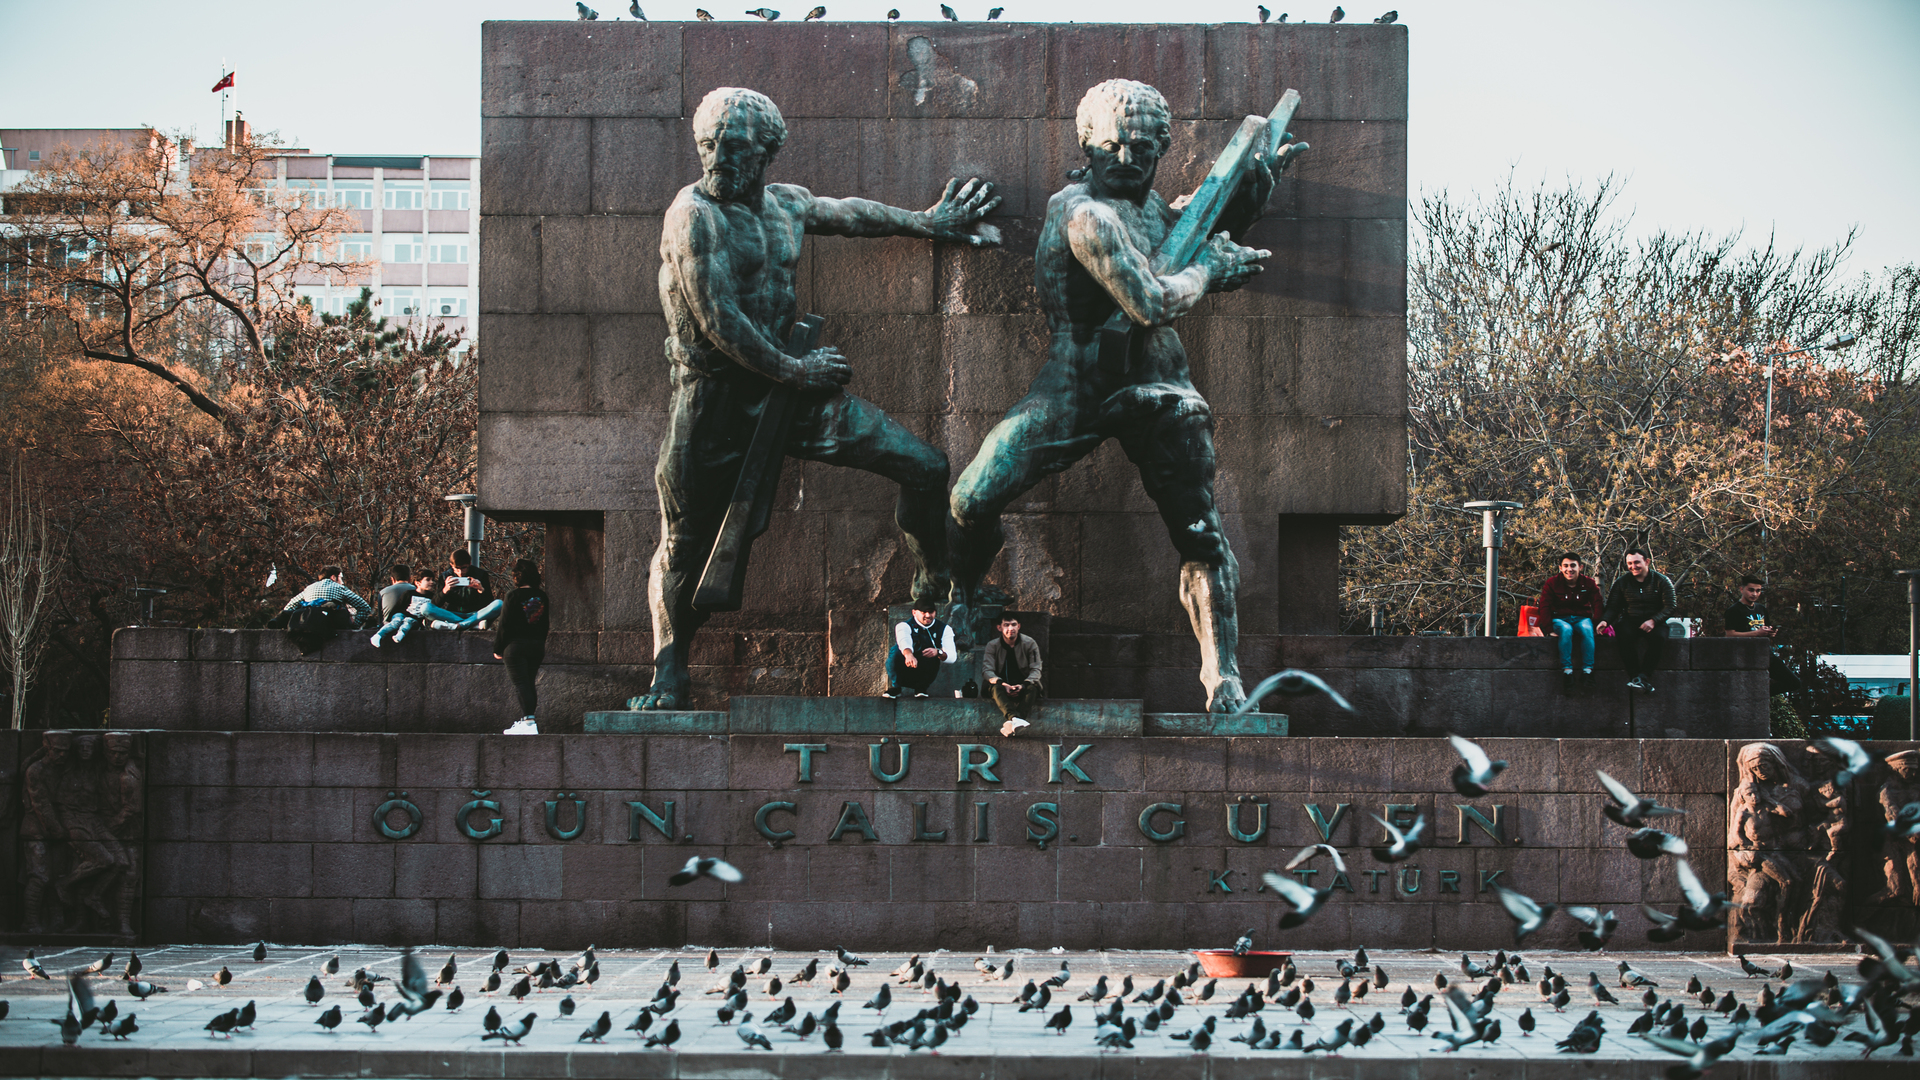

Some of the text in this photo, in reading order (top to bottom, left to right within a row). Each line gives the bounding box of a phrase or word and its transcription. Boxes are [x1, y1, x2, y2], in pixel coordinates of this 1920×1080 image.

[783, 737, 1095, 784] TÜRK
[373, 789, 694, 842] ÖĞÜN.
[754, 801, 1078, 849] ÇALIŞ.
